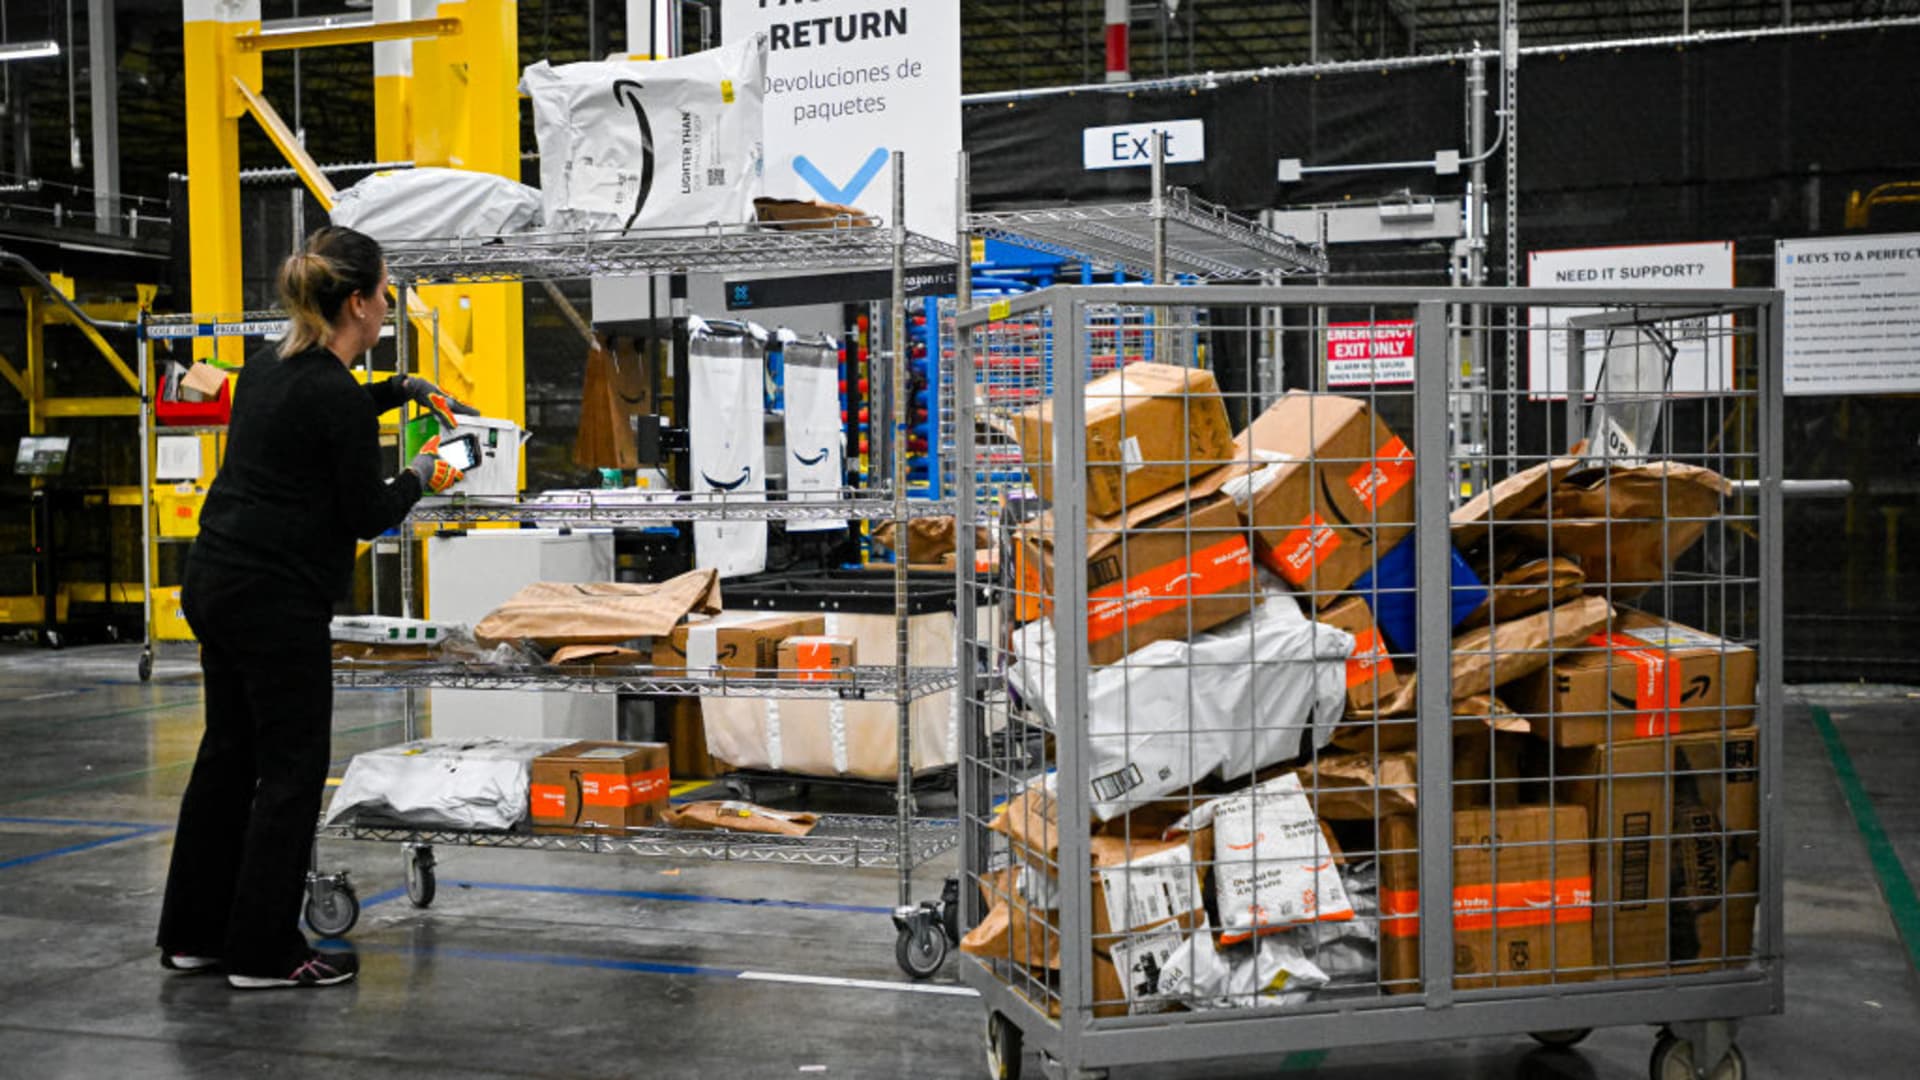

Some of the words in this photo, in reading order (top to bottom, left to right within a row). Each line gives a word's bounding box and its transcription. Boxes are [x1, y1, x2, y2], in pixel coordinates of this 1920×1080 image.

[770, 7, 907, 51] RETURN
[897, 58, 922, 78] de
[794, 96, 886, 125] paquetes
[681, 111, 691, 143] THAN
[1112, 128, 1174, 160] Ext
[681, 146, 691, 194] LIGHTER
[1797, 252, 1829, 264] KEYS
[1833, 251, 1850, 262] TO
[1854, 251, 1864, 261] A
[1556, 269, 1598, 282] NEED
[1602, 268, 1615, 280] IT
[1620, 263, 1704, 279] SUPPORT?
[1335, 341, 1366, 358] EXIT
